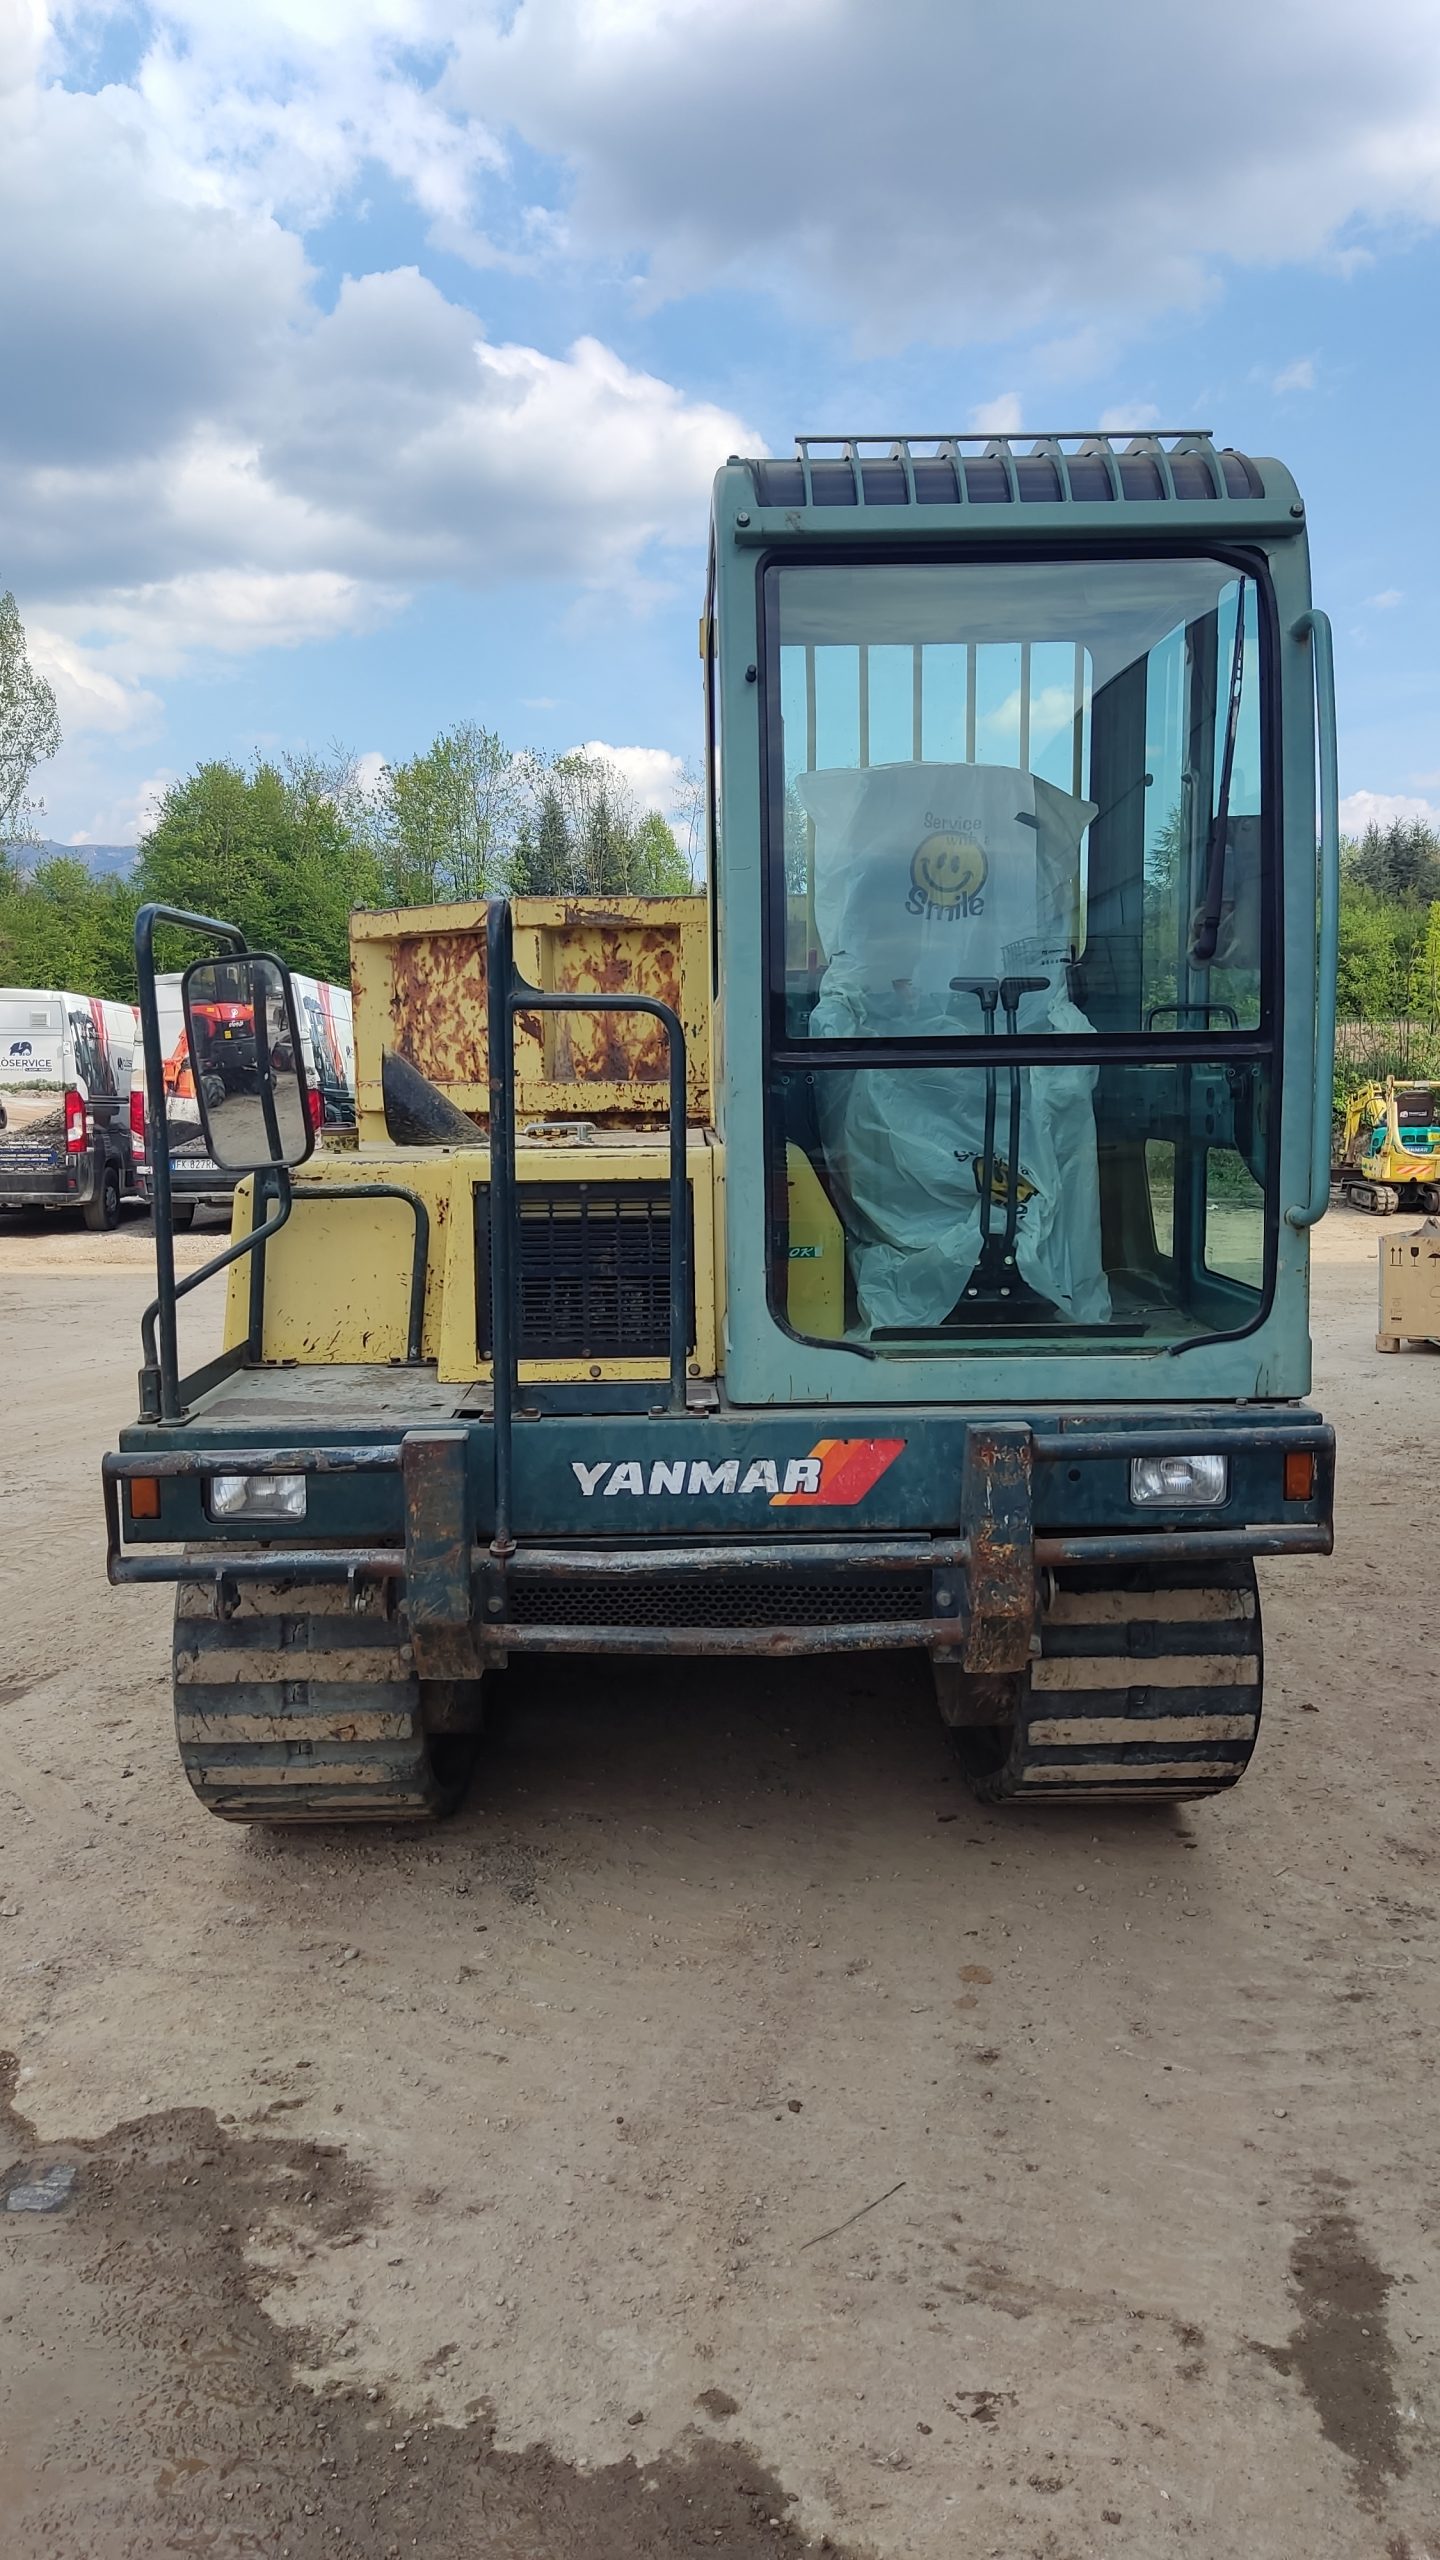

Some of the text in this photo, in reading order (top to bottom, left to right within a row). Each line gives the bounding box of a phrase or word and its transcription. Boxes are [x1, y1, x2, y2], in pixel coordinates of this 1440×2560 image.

[923, 811, 982, 831] Service
[905, 886, 985, 922] Smile
[0, 1056, 52, 1068] ÒSERVICE
[789, 1247, 814, 1257] OK
[572, 1458, 822, 1496] YANMAR
